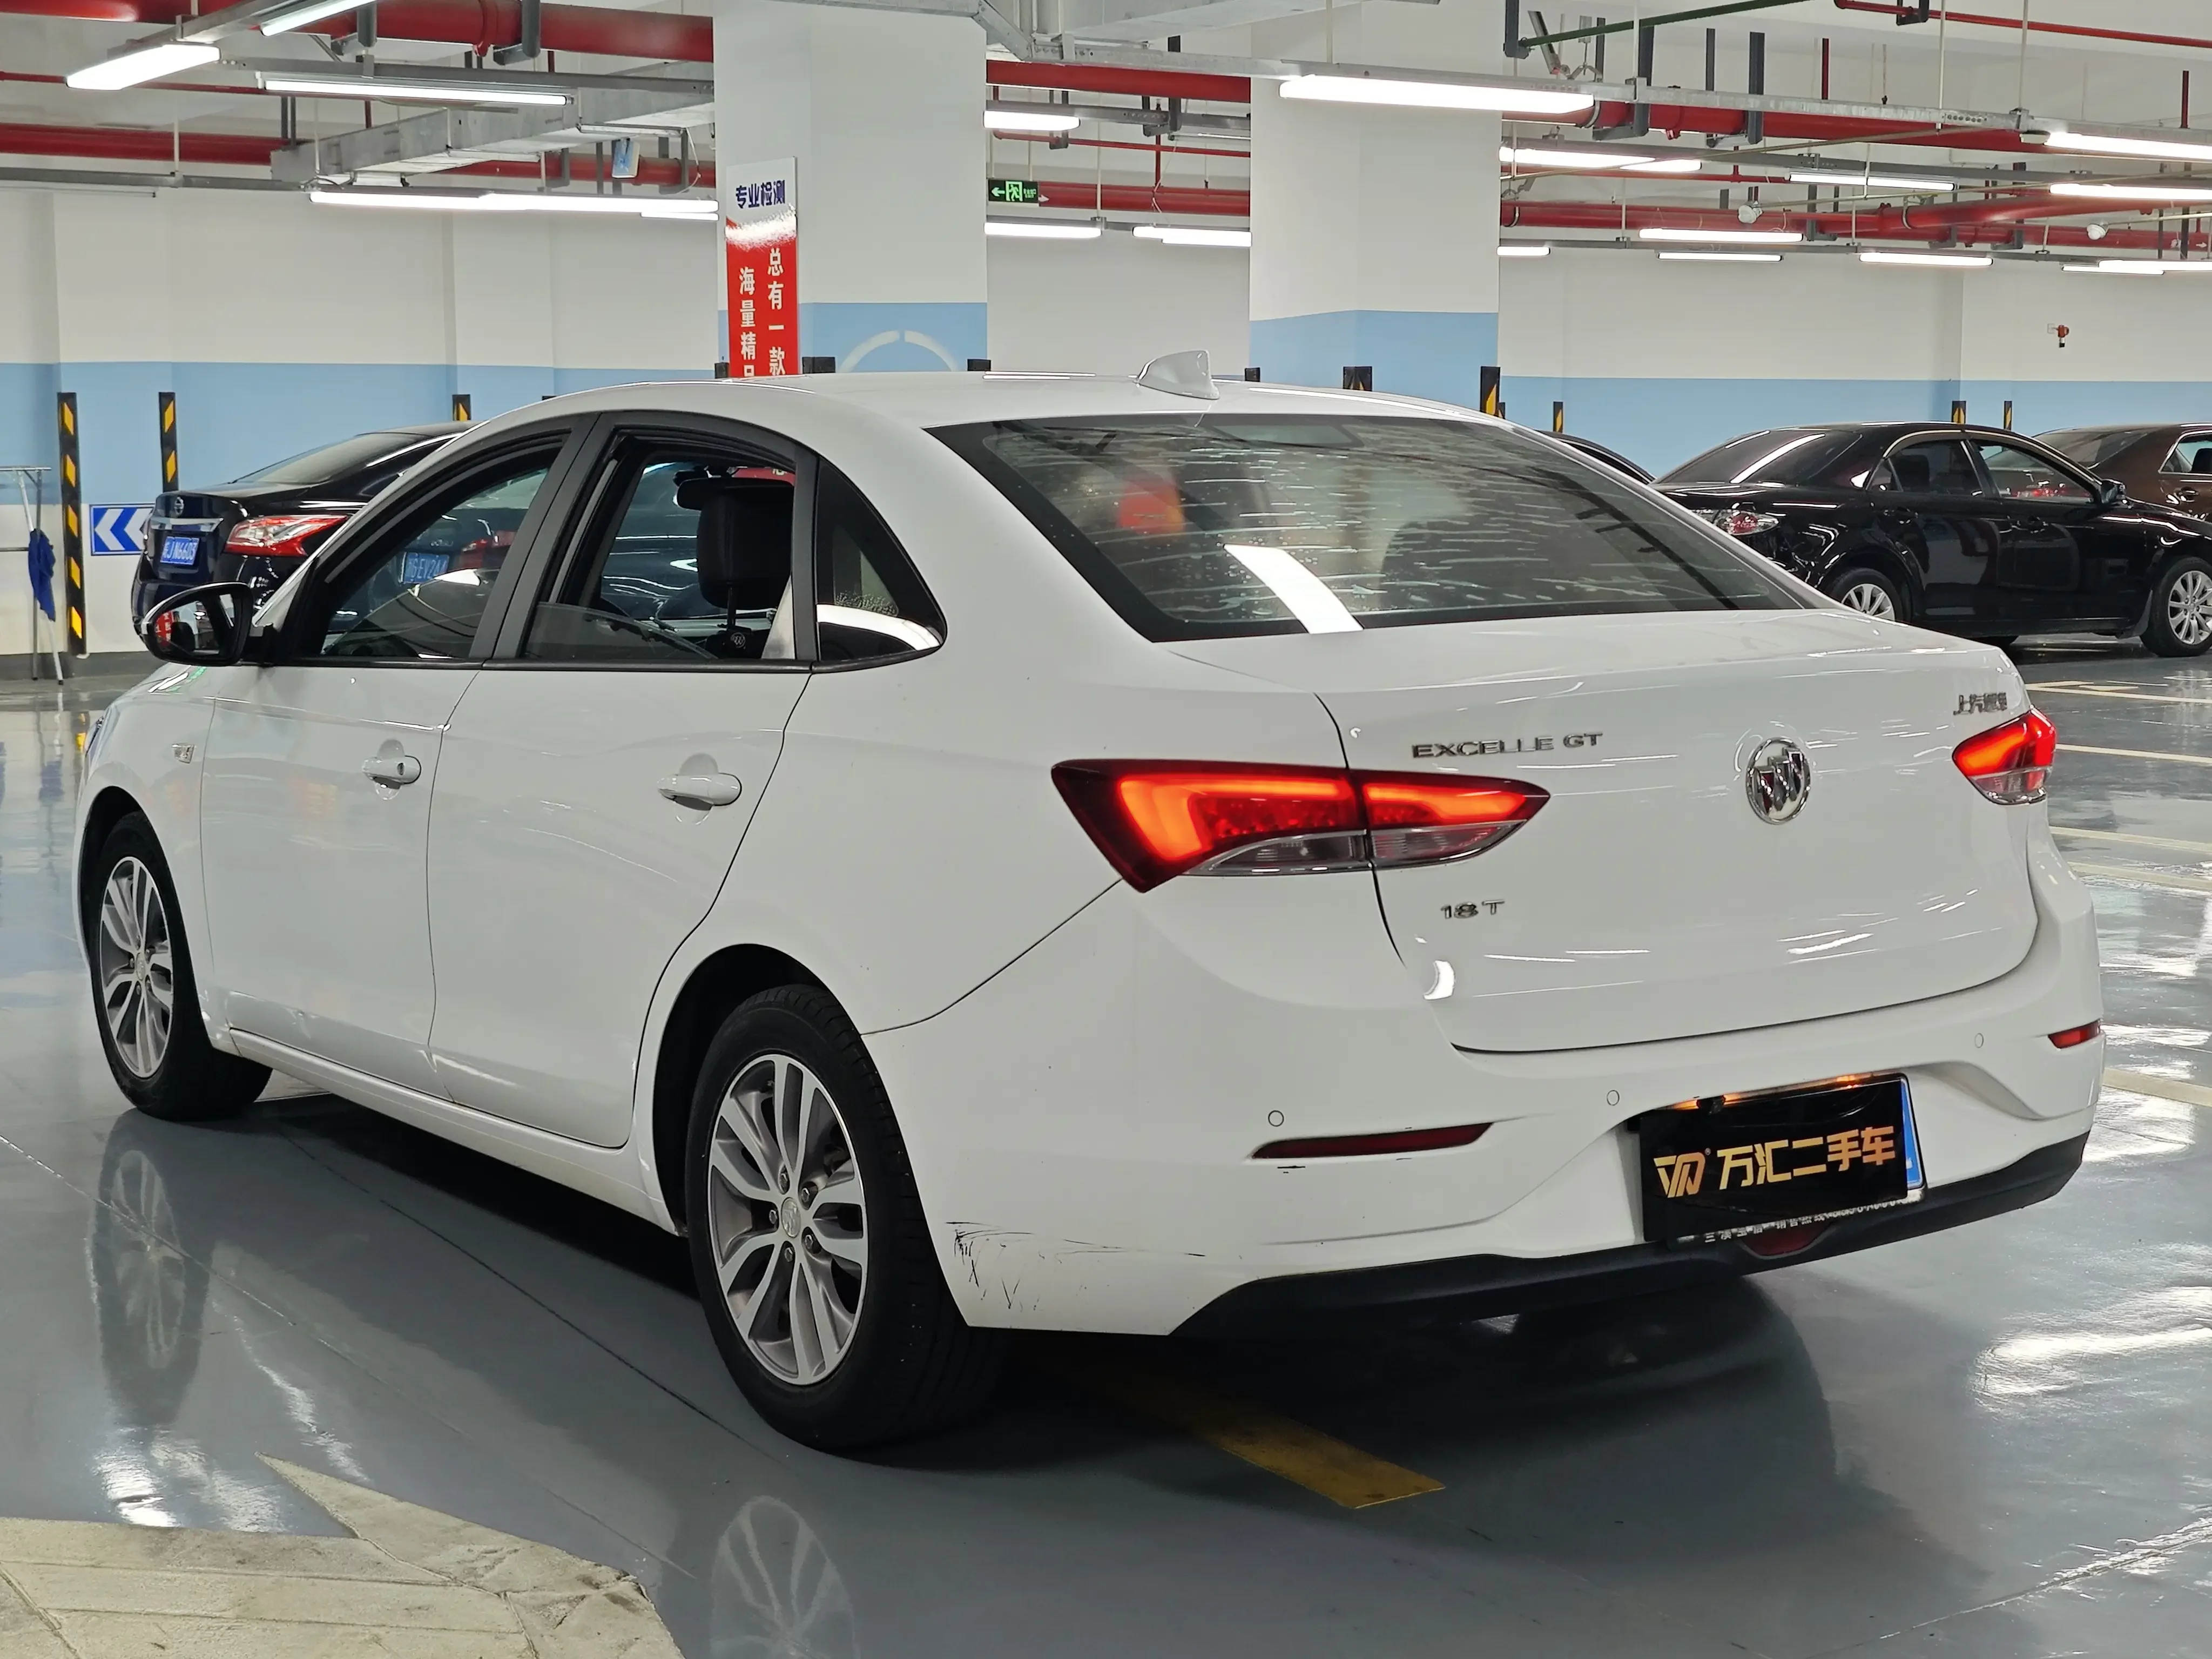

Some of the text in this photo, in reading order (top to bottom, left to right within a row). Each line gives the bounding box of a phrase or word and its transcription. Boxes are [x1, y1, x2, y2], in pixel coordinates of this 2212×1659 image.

[735, 180, 785, 209] 专业检测
[767, 247, 786, 376] 总有一款
[1412, 732, 1603, 758] EXCELLE GT
[1716, 1125, 1896, 1190] 万汇二手车
